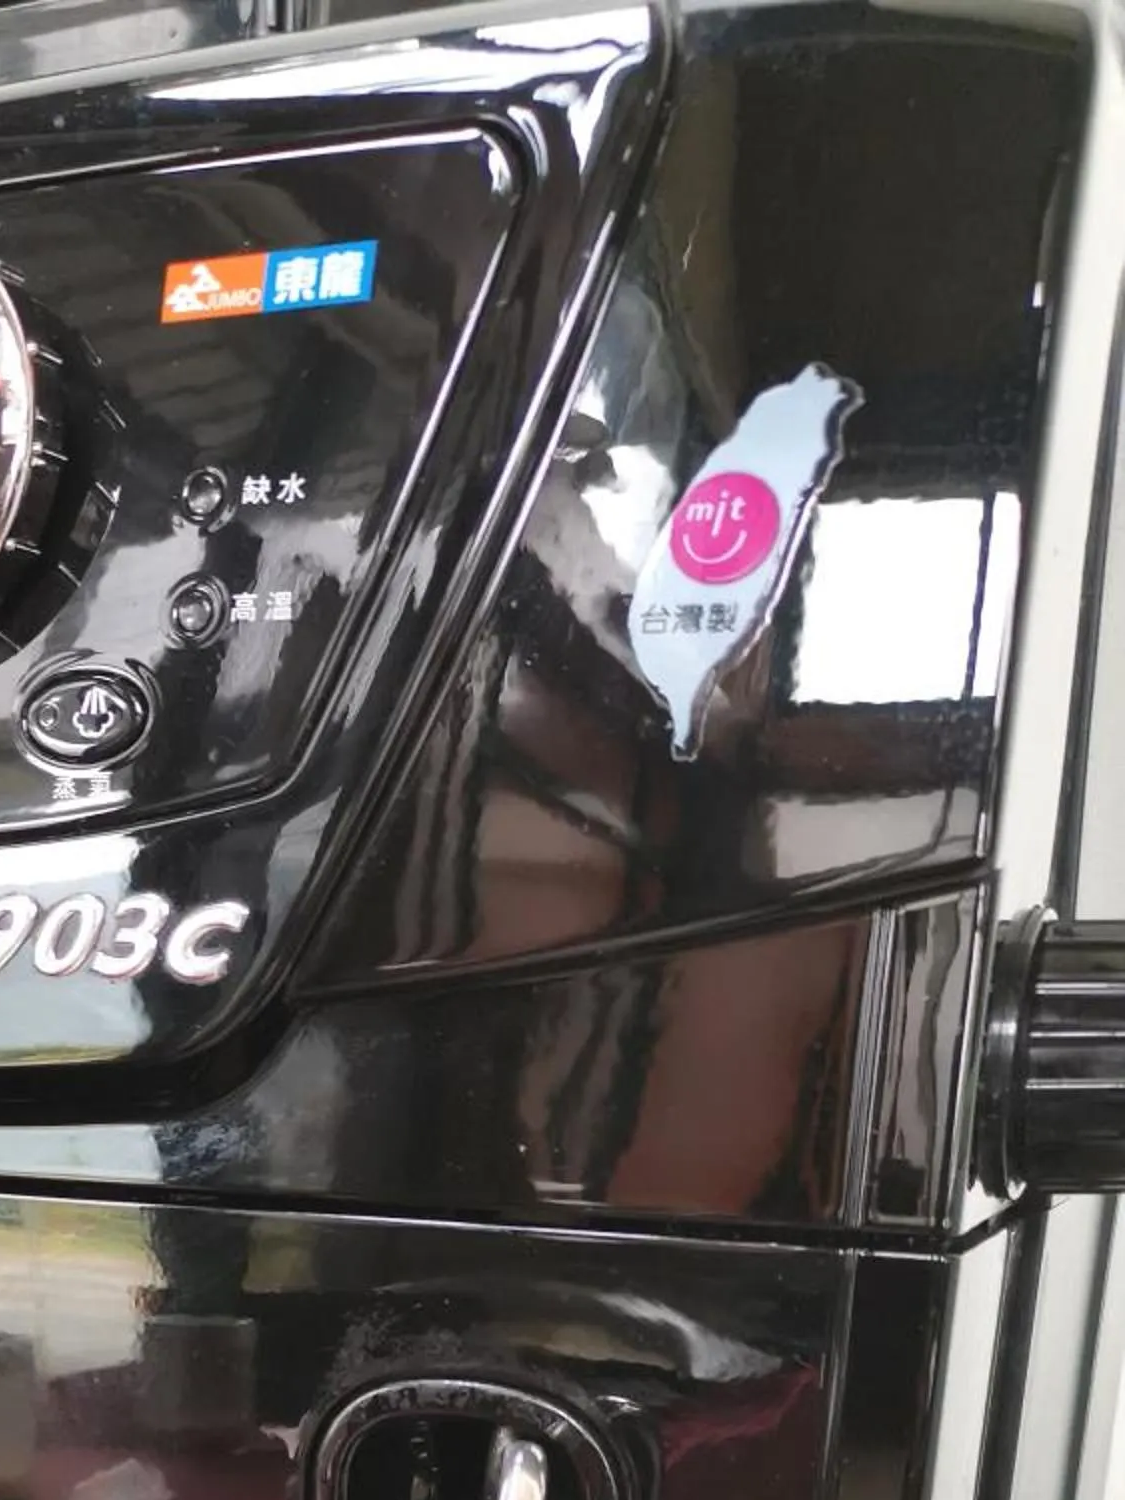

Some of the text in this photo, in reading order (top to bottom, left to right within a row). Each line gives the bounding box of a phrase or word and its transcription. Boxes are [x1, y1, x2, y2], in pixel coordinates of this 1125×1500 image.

[241, 471, 307, 505] 缺水
[640, 601, 739, 635] 台灣製
